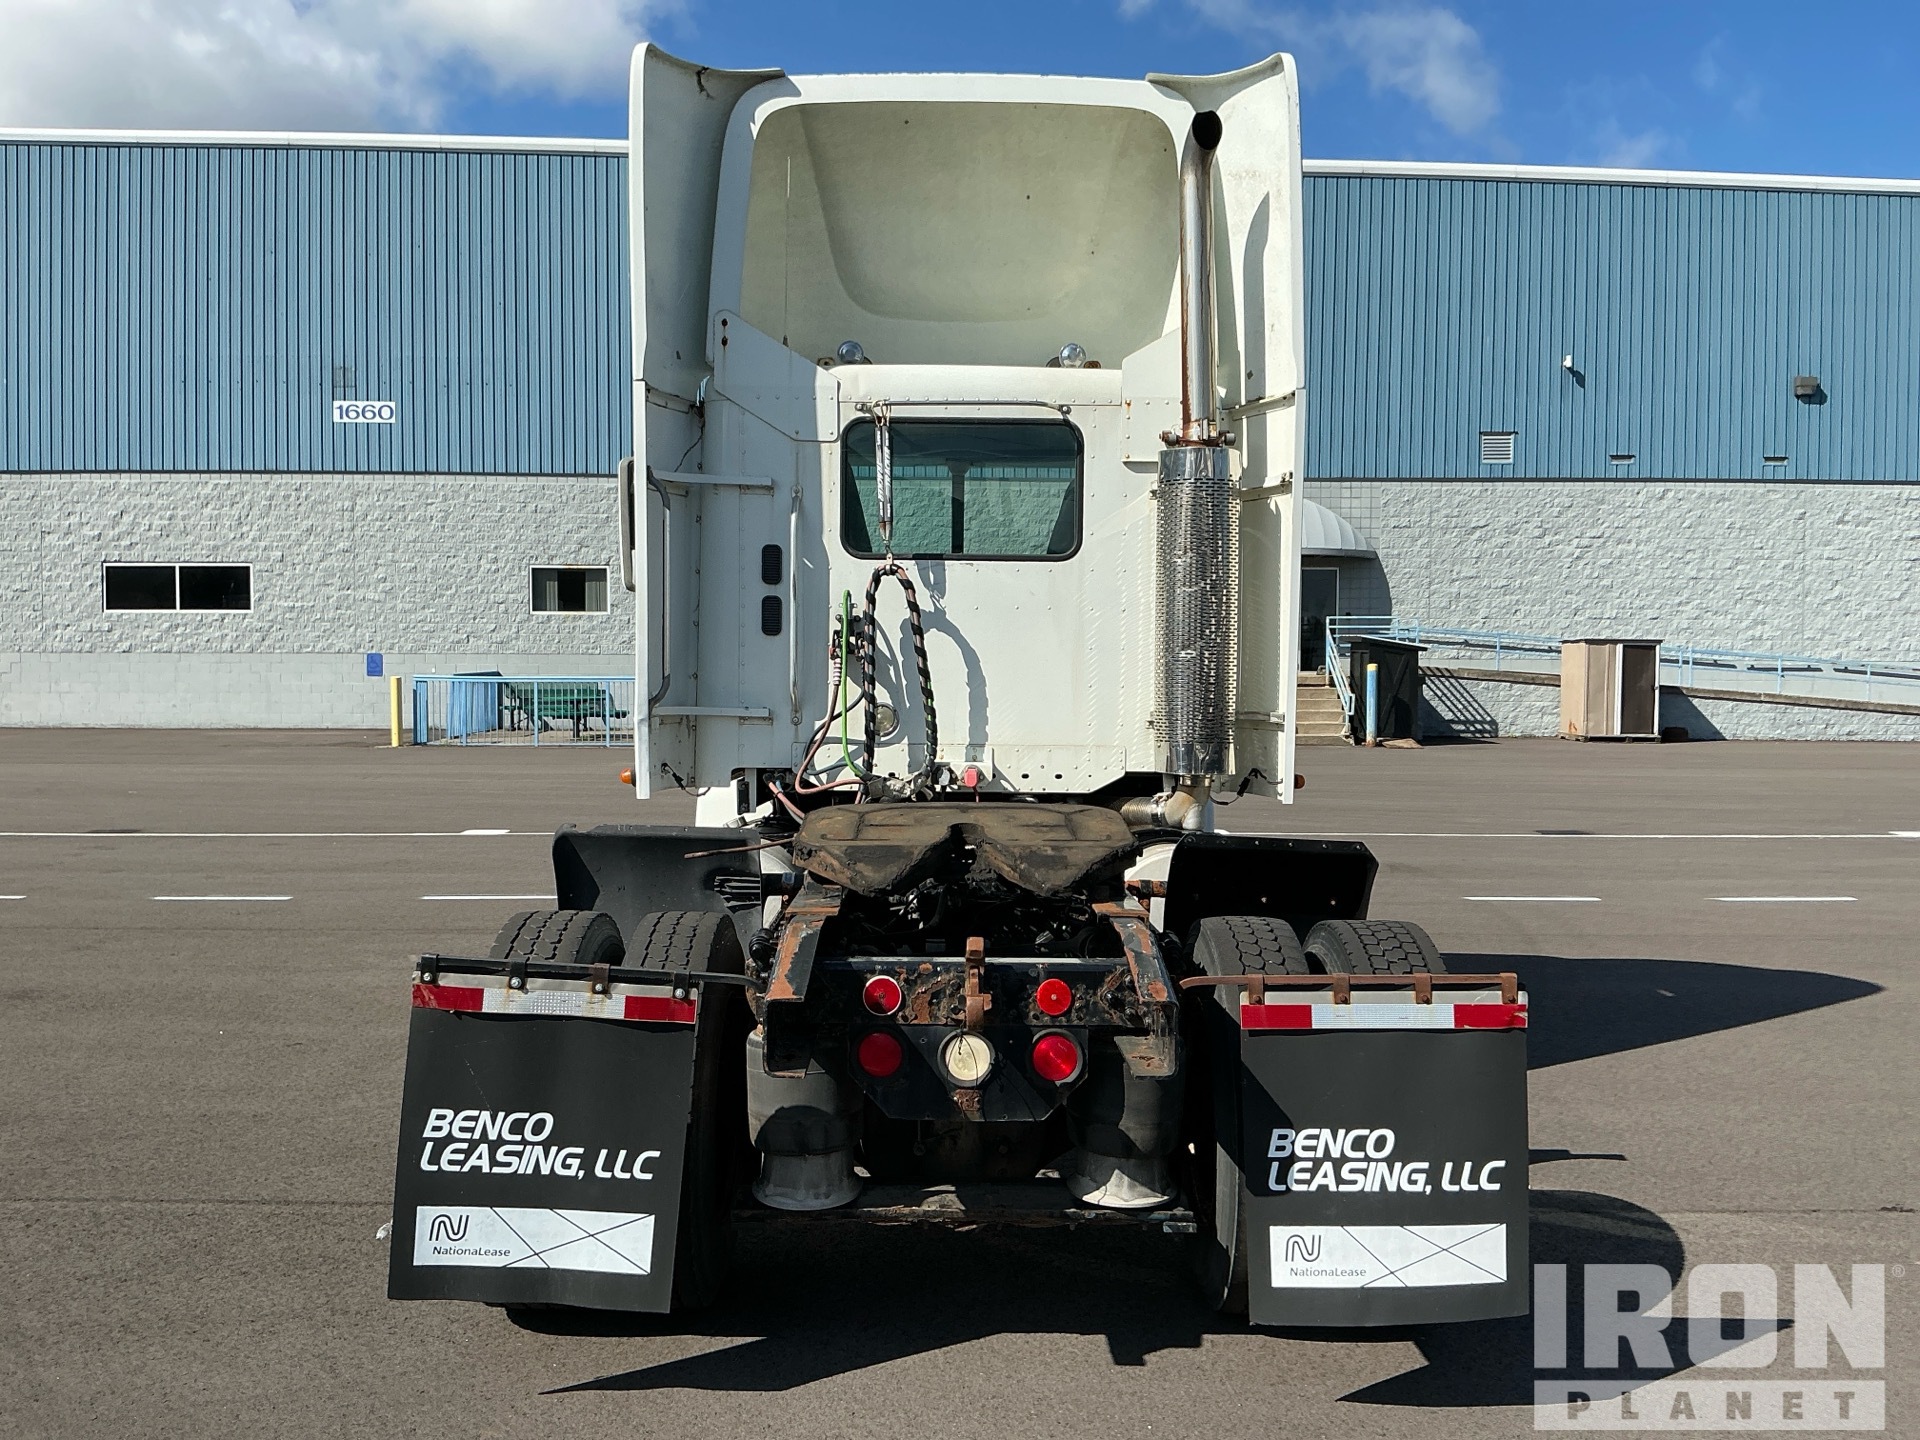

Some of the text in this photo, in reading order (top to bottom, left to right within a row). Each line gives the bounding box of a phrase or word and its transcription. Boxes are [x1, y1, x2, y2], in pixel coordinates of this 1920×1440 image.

[335, 404, 394, 420] 1660
[422, 1108, 554, 1141] BENCO
[1268, 1128, 1395, 1158] BENCO
[420, 1142, 661, 1180] LEASING, LLC
[1268, 1160, 1506, 1195] LEASING, LLC
[432, 1245, 511, 1257] NationaLease
[1289, 1266, 1367, 1277] NationaLease
